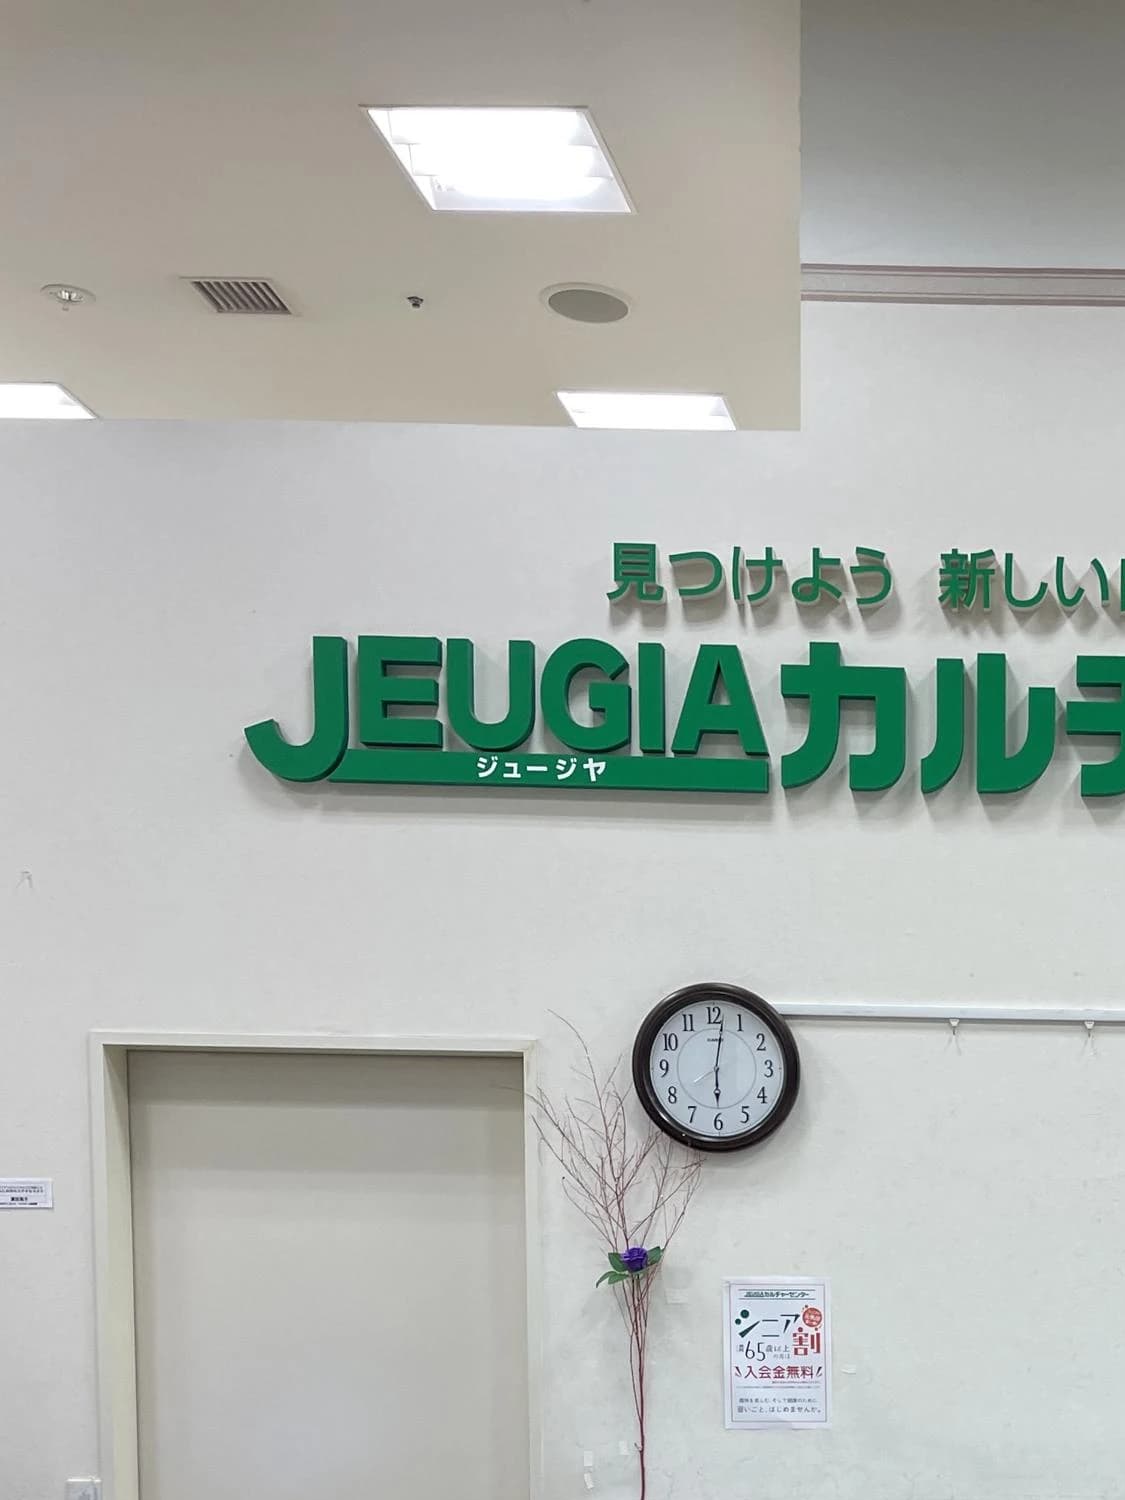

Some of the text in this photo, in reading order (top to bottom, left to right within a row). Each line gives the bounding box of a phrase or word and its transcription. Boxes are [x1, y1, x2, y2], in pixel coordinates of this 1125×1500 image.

[608, 543, 893, 606] 見つけよう
[681, 1013, 695, 1032] 11
[706, 1006, 722, 1025] 12
[736, 1013, 744, 1032] 1
[662, 1032, 679, 1052] 10
[756, 1033, 767, 1052] 2
[659, 1059, 670, 1078] 9
[764, 1060, 774, 1078] 3
[667, 1086, 678, 1104] 8
[756, 1086, 768, 1104] 4
[687, 1105, 698, 1124] 7
[713, 1112, 724, 1131] 6
[740, 1105, 751, 1124] 5
[735, 1309, 800, 1338] シニア
[792, 1326, 821, 1356] 割
[744, 1365, 814, 1379] 入会金無料
